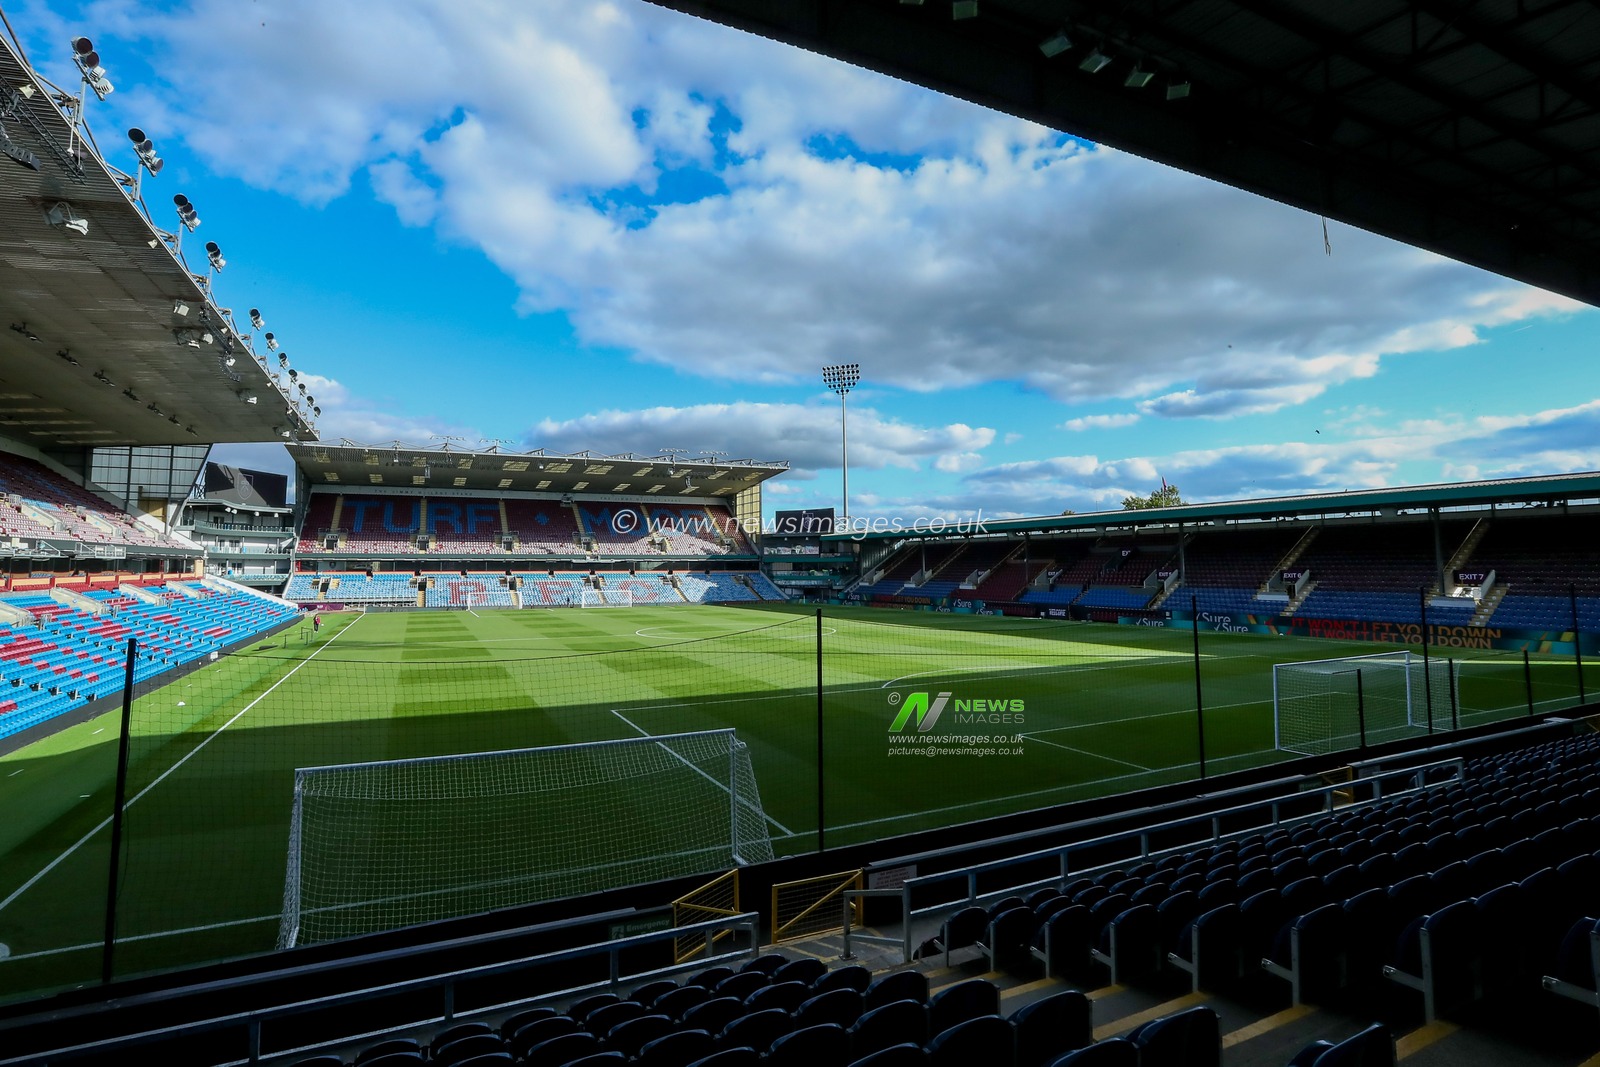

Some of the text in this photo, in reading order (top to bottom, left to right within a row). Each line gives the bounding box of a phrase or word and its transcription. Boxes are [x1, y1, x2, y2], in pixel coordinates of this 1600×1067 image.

[343, 500, 500, 533] TURF
[1142, 617, 1165, 628] Sure
[1202, 612, 1232, 624] Sure
[1222, 623, 1249, 633] Sure
[1438, 626, 1502, 640] DOWN
[1371, 631, 1399, 644] LET
[1437, 635, 1493, 650] DOWN
[626, 919, 670, 933] Emergency
